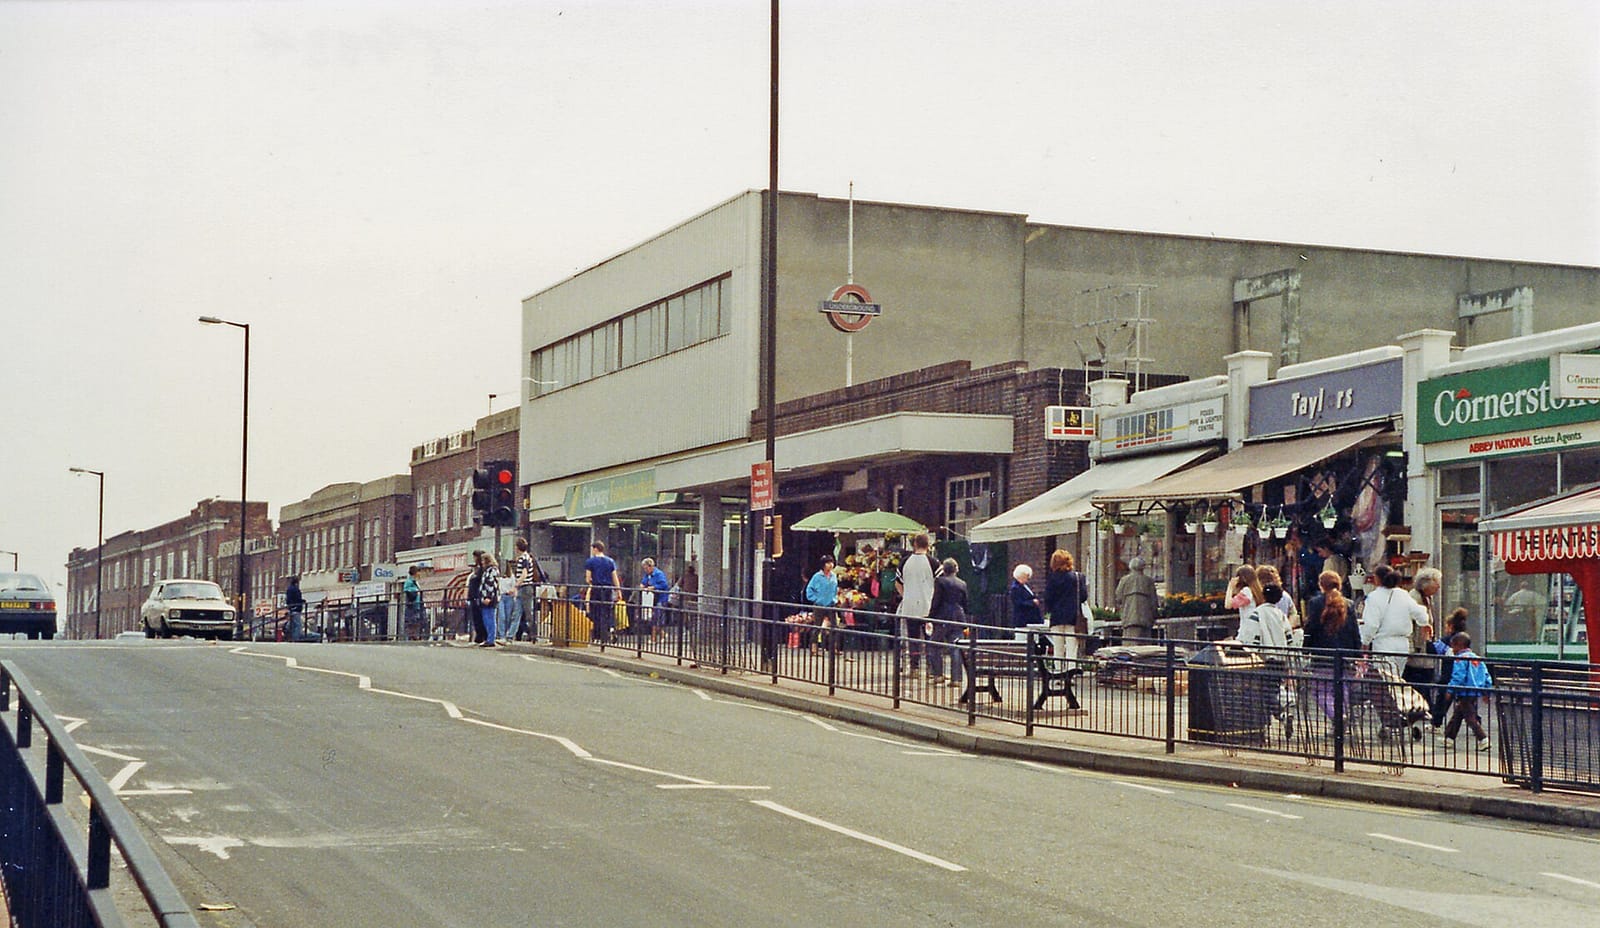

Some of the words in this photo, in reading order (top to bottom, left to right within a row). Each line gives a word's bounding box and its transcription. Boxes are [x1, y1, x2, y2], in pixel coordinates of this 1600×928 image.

[829, 302, 876, 312] UNDERGROUND
[1197, 423, 1214, 432] CENTRE
[1469, 440, 1493, 454] ABBEY
[1495, 436, 1532, 451] NATIONAL
[1533, 435, 1555, 446] Estate
[1556, 431, 1582, 444] Agents
[1517, 535, 1539, 551] THE
[374, 567, 394, 578] Gas
